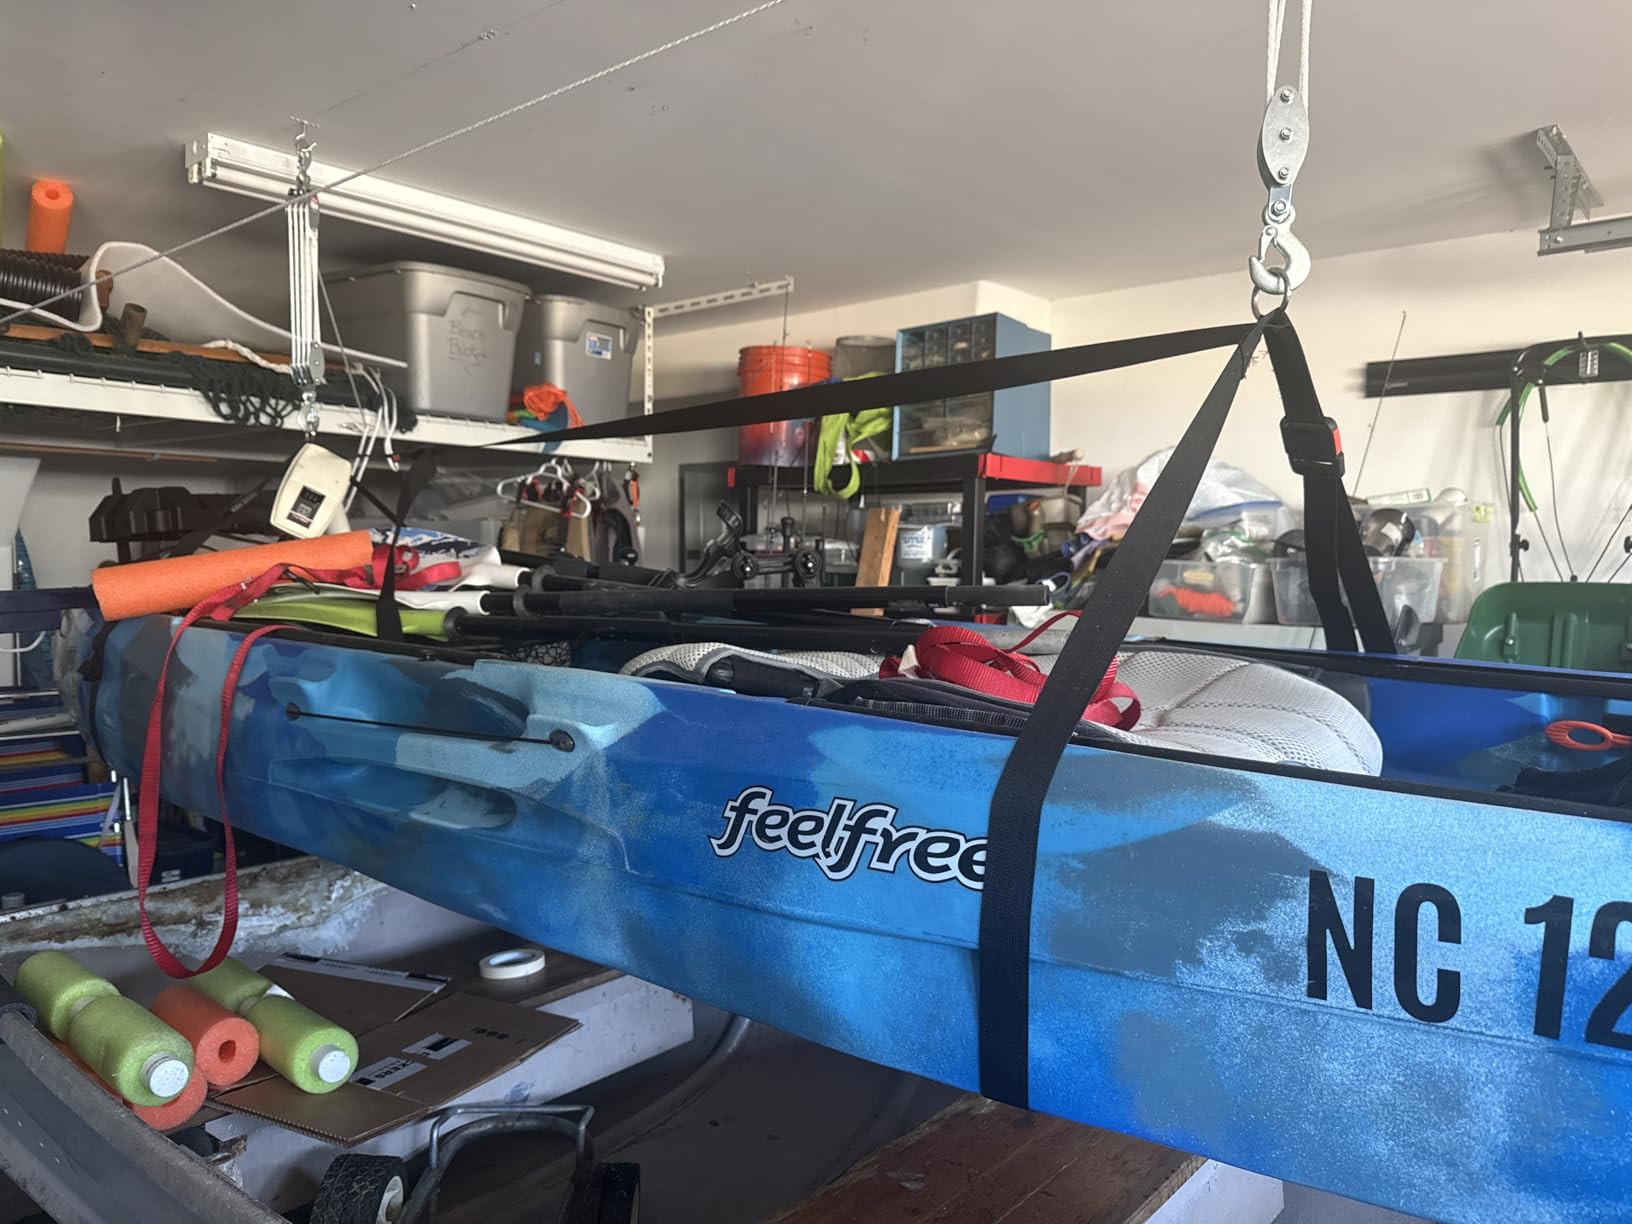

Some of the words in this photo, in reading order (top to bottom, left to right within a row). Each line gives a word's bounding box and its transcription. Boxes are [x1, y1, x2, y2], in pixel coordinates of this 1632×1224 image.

[709, 785, 988, 891] feelfree
[1306, 868, 1462, 1024] NC
[1524, 894, 1632, 1051] 12
